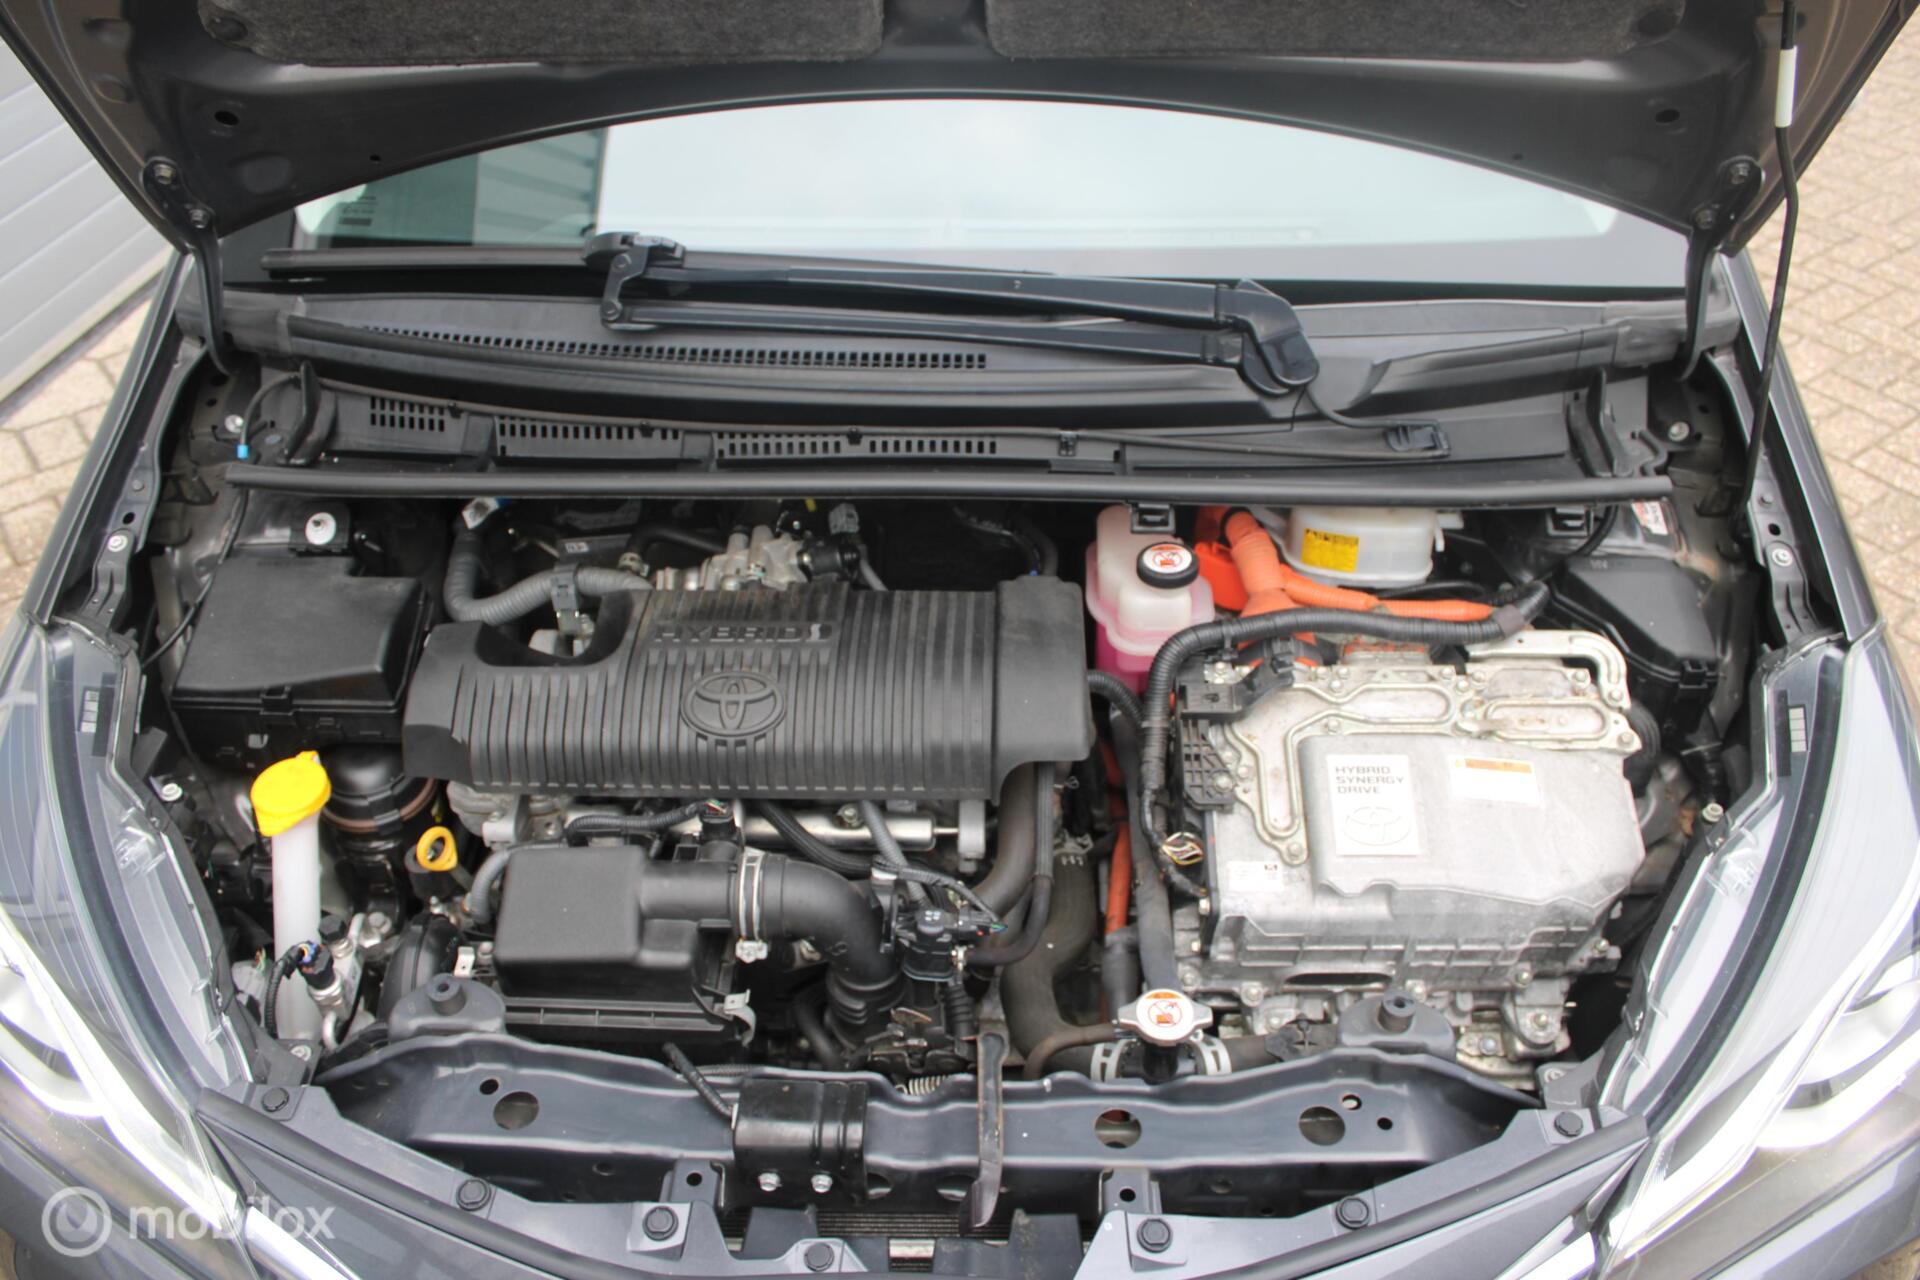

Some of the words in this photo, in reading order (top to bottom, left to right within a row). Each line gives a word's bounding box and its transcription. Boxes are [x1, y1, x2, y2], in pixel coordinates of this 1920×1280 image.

[654, 624, 802, 643] HYBRID
[1335, 765, 1391, 775] HYBRID
[1335, 775, 1405, 785] SYNERGY
[1337, 785, 1381, 794] DRIVE
